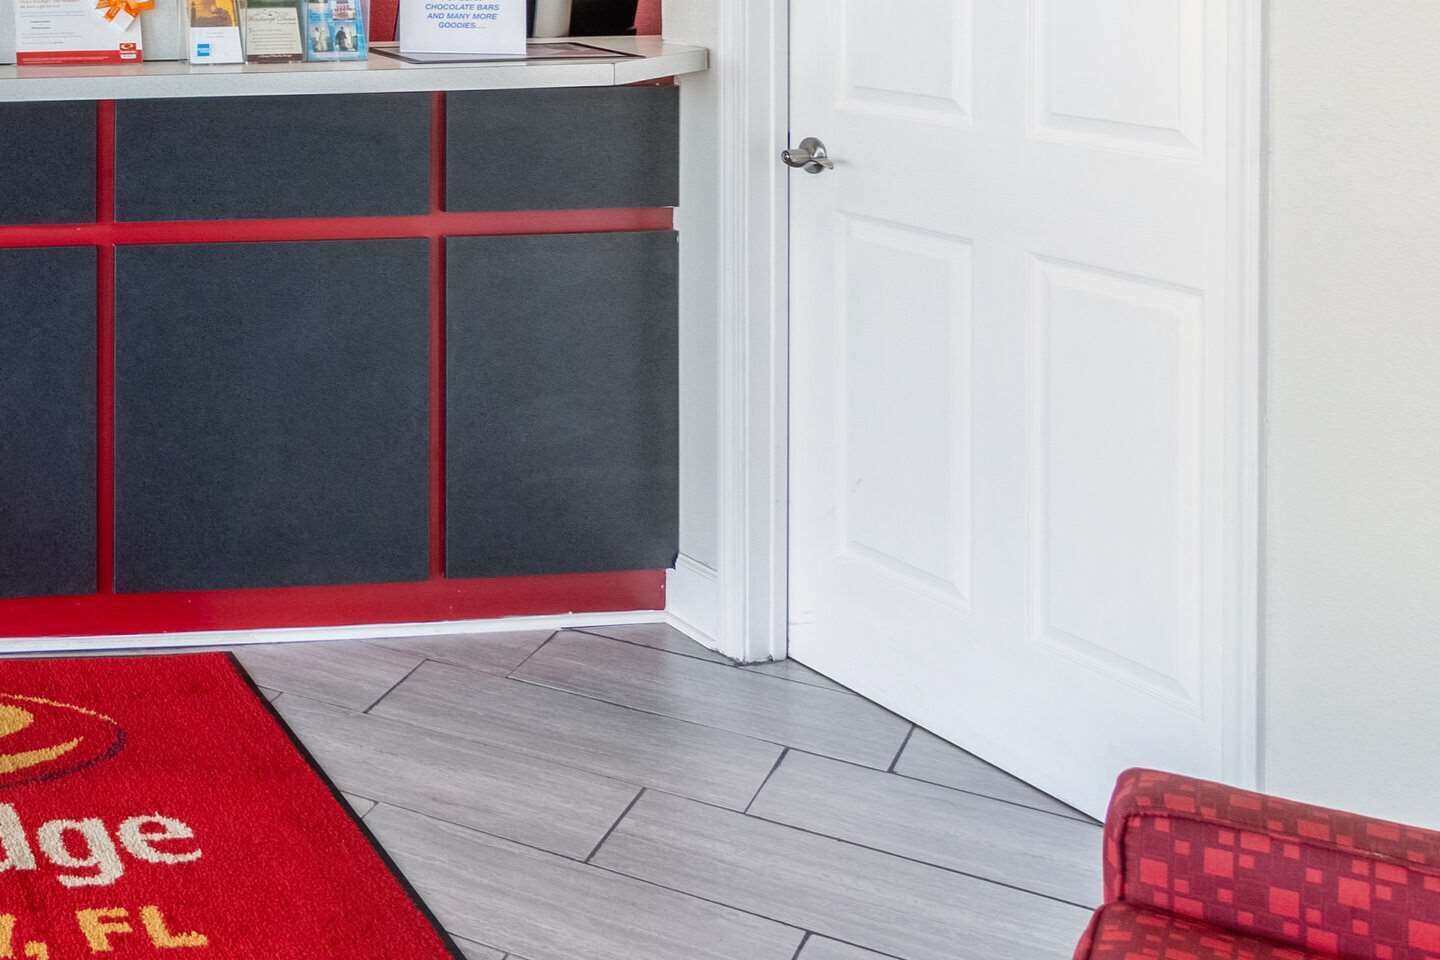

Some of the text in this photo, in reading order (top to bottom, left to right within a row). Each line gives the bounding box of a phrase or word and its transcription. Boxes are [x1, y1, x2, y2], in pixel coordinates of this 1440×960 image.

[425, 3, 500, 11] CHOCOLATE BARS
[427, 12, 445, 20] AND
[76, 905, 209, 953] FL
